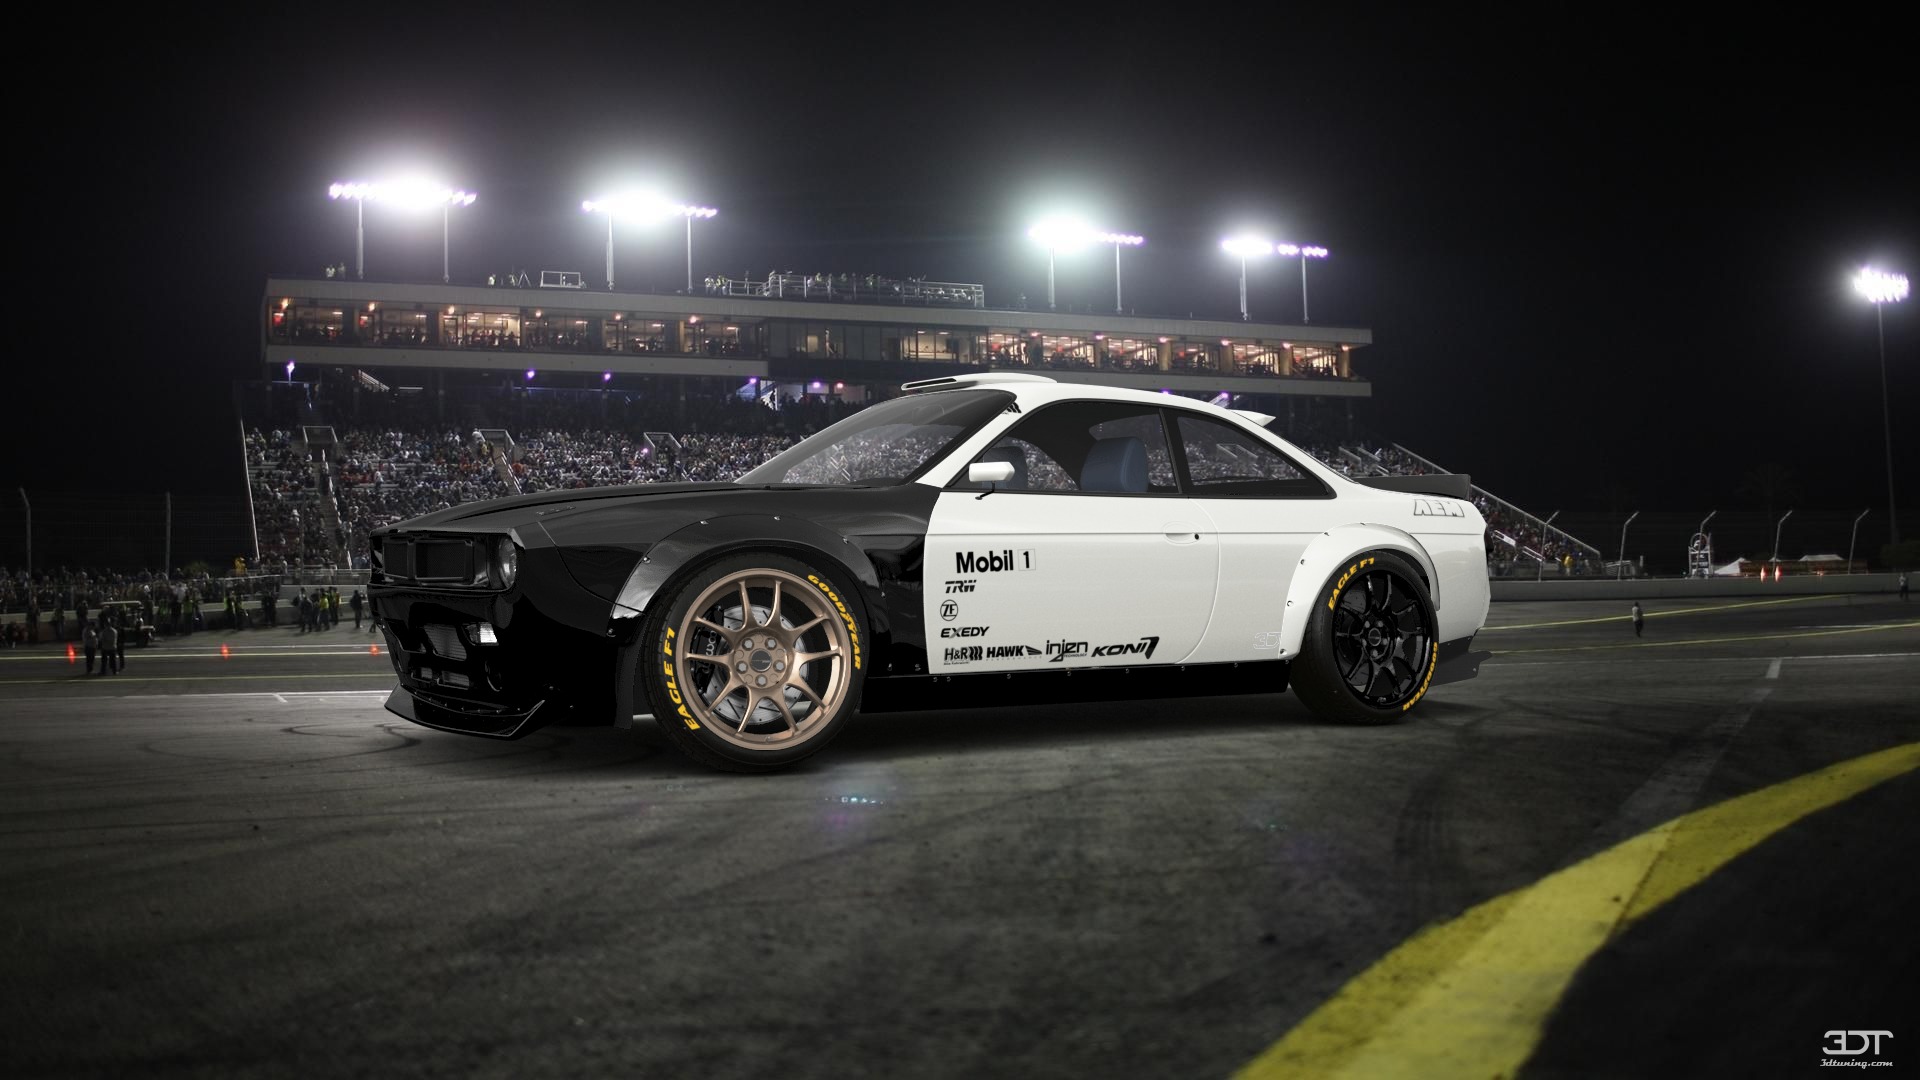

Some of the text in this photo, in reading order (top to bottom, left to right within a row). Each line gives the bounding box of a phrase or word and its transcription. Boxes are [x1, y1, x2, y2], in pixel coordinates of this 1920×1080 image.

[1413, 499, 1465, 517] AEM
[956, 550, 1014, 573] Mobil
[945, 580, 977, 594] TRW
[1328, 557, 1375, 611] EAGLE F1
[808, 574, 861, 670] GOODYEAR
[941, 626, 990, 638] EXEDY
[945, 647, 969, 661] H&R
[986, 646, 1025, 659] HAWK
[1091, 641, 1149, 658] KONI
[664, 626, 701, 730] EAGLE F1
[1403, 642, 1438, 711] GOODYEAR
